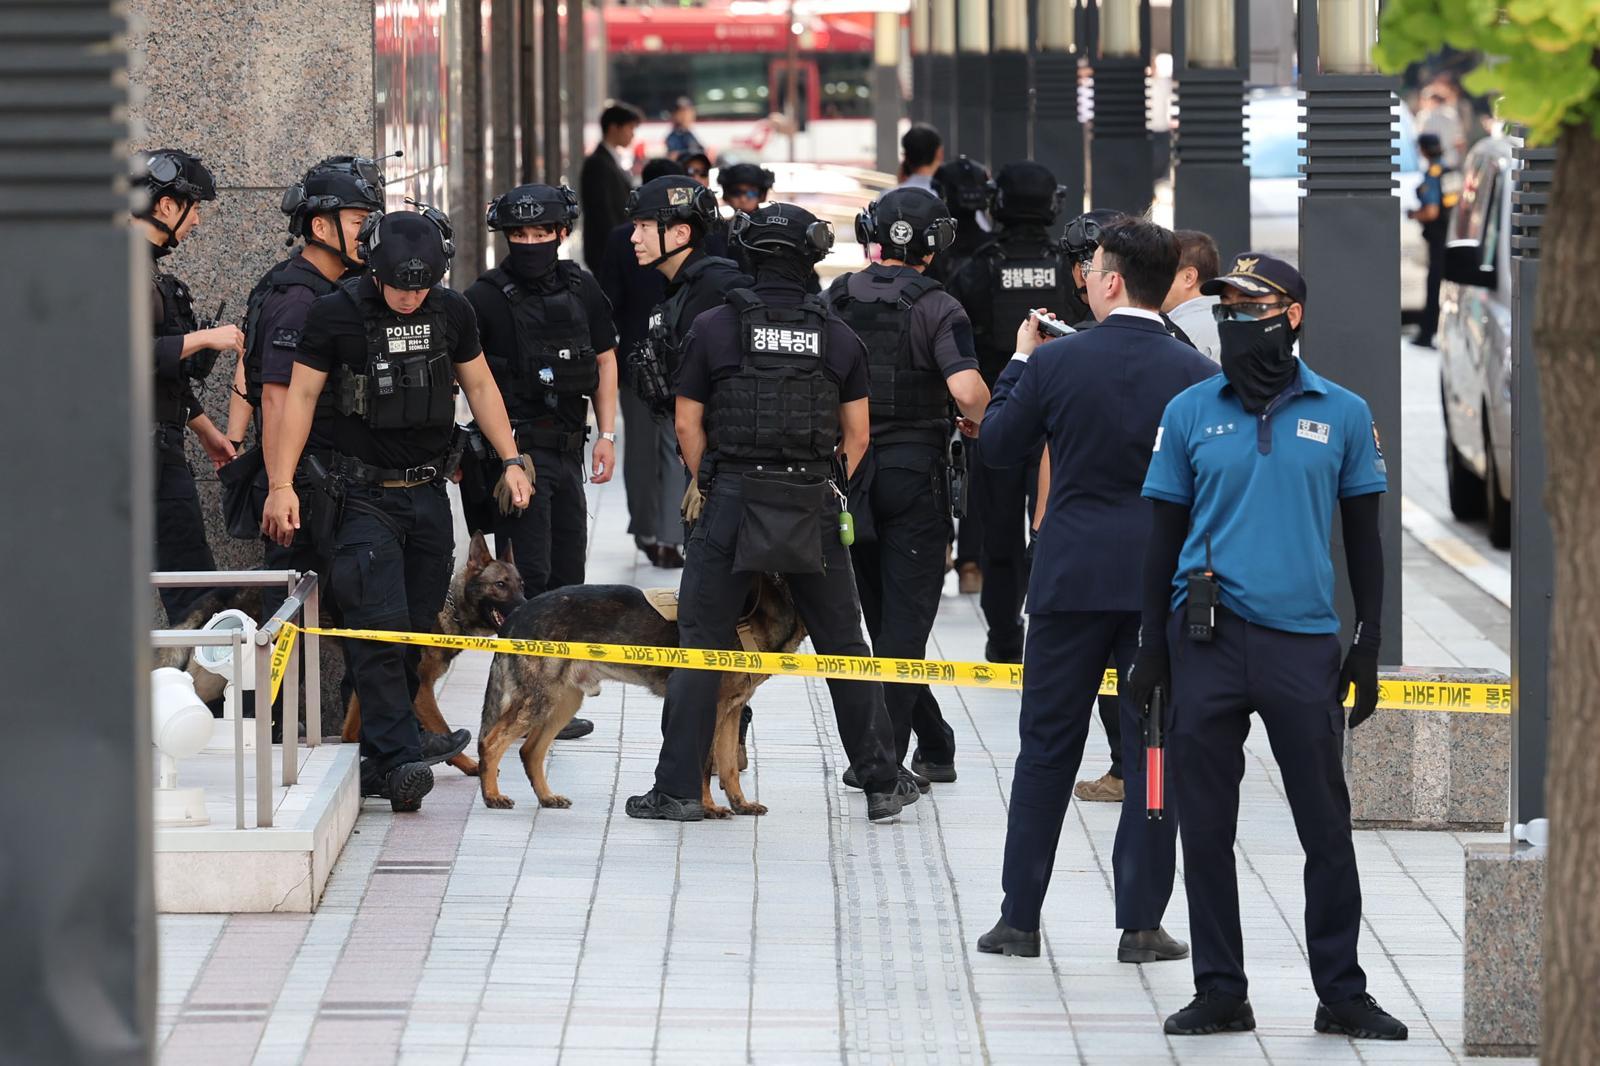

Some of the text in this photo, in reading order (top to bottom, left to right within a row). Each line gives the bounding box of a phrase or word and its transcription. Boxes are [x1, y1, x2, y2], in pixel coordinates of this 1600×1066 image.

[1002, 268, 1056, 288] 경찰특공대
[386, 324, 431, 337] POLICE
[754, 328, 819, 354] 경찰특공대
